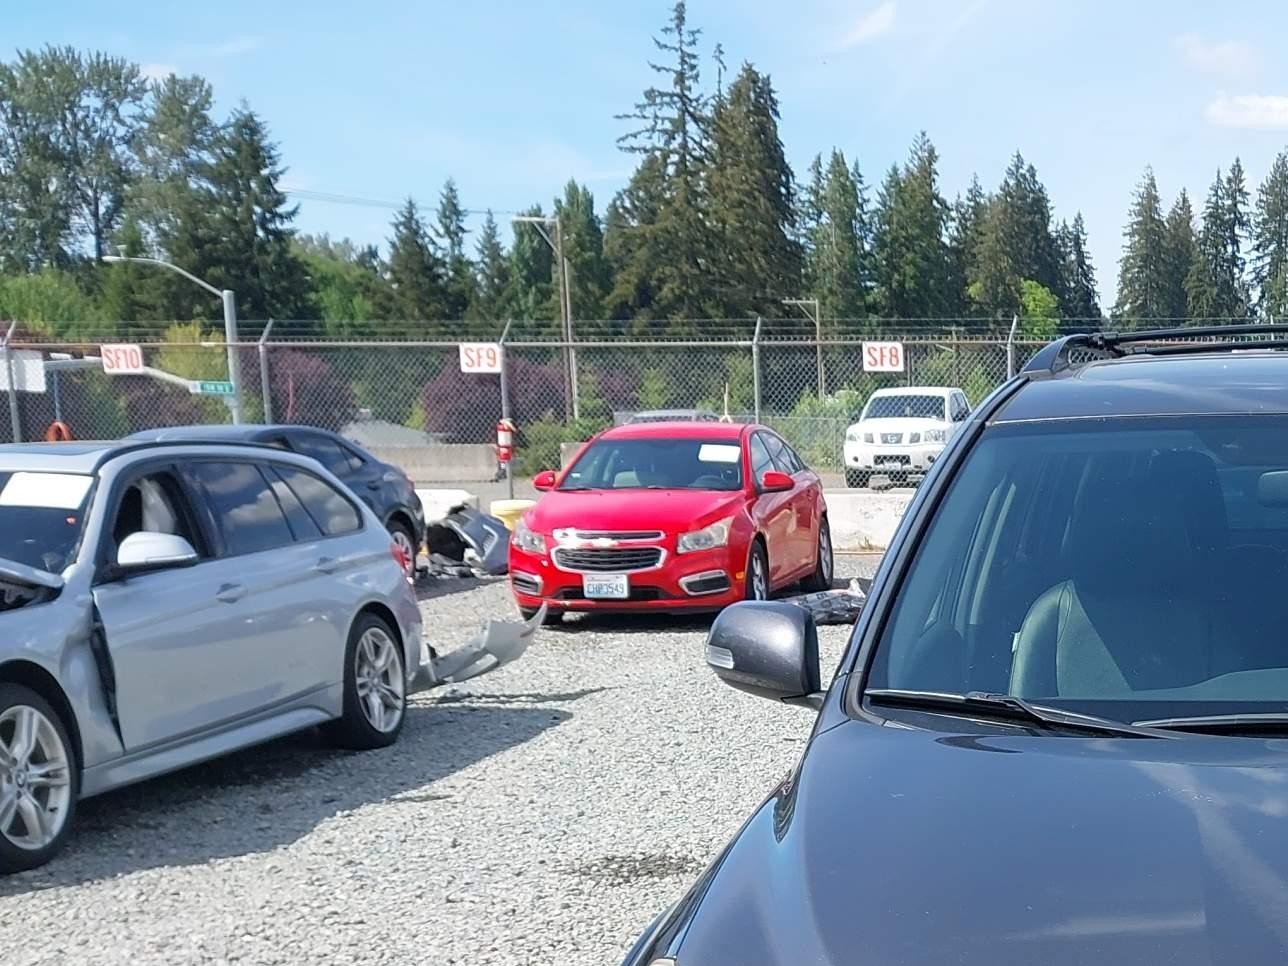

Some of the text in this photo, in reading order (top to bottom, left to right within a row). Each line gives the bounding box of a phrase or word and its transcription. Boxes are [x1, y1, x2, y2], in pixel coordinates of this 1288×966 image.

[103, 348, 140, 369] SF10
[464, 347, 497, 368] SF9
[867, 346, 900, 367] SF8
